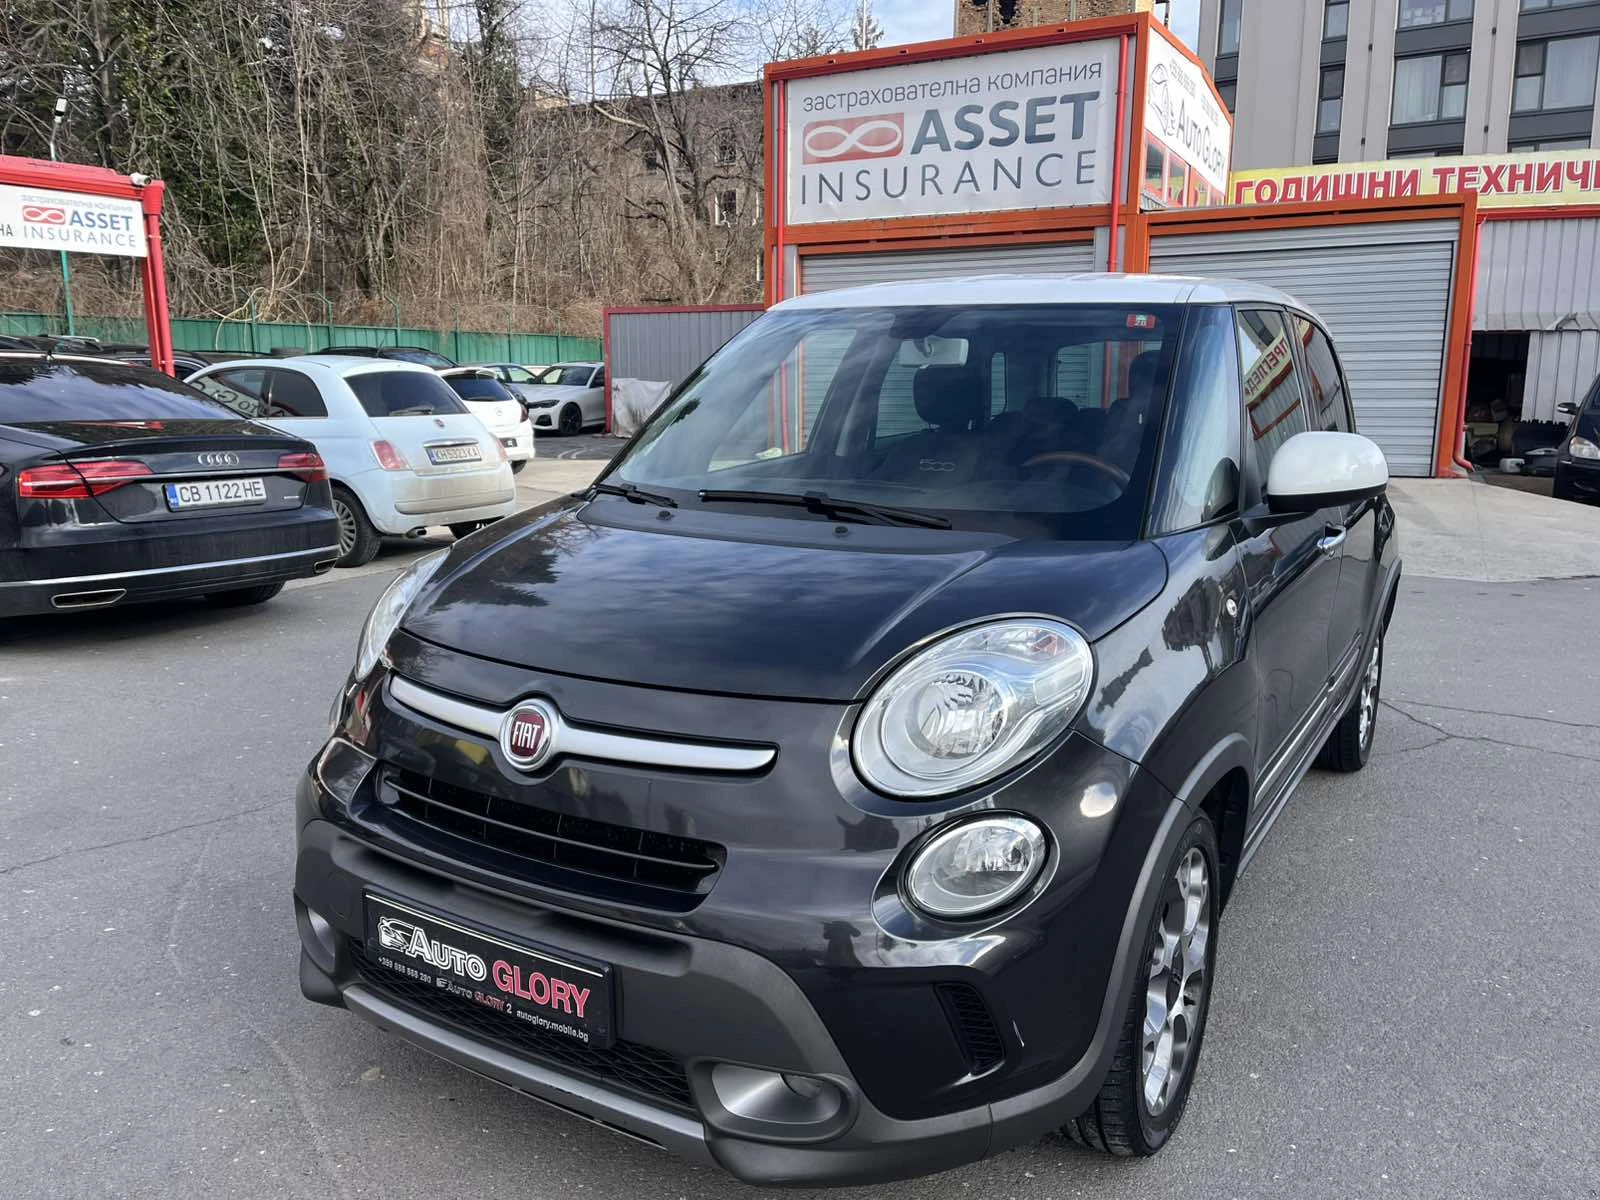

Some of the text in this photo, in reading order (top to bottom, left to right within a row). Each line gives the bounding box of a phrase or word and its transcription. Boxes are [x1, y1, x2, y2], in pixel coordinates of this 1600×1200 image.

[802, 62, 1102, 112] застрахователна компания
[910, 91, 1100, 155] ASSET
[801, 150, 1097, 205] INSURANCE
[1235, 169, 1421, 205] ГОДИШНИ
[1432, 159, 1600, 197] ТЕХНИЧ
[23, 225, 136, 247] INSURANCE
[69, 210, 133, 231] ASSET
[179, 481, 263, 502] CB 1122 HE
[512, 721, 541, 749] FIAT
[492, 960, 591, 1018] GLORY
[506, 1003, 513, 1014] 2
[516, 1009, 589, 1043] autoglory.mobile.bg
